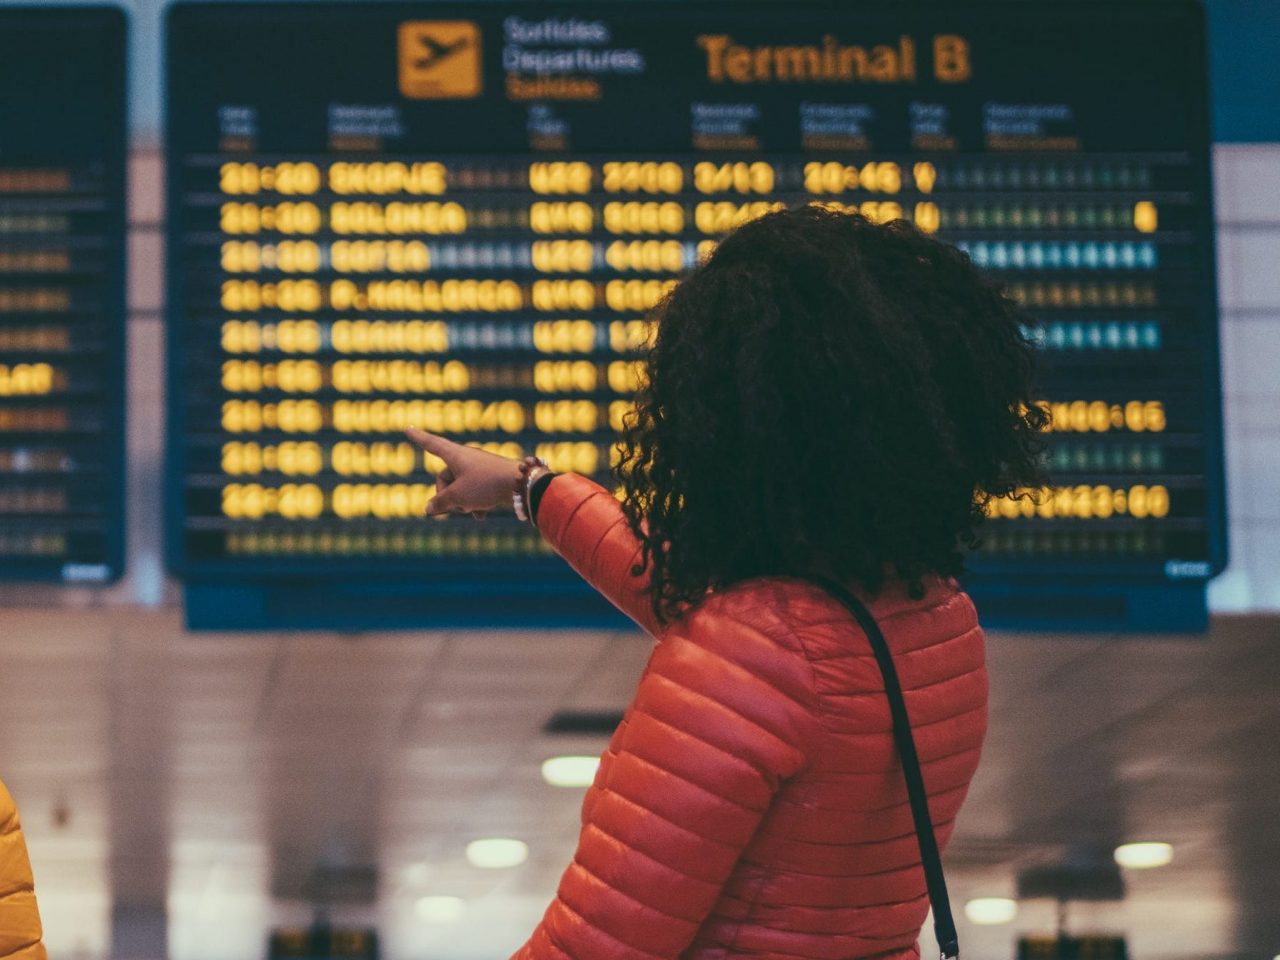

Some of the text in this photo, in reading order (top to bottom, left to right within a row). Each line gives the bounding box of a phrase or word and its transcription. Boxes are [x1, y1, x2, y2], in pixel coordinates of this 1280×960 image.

[502, 43, 644, 74] Departures
[695, 34, 971, 83] Terminal B
